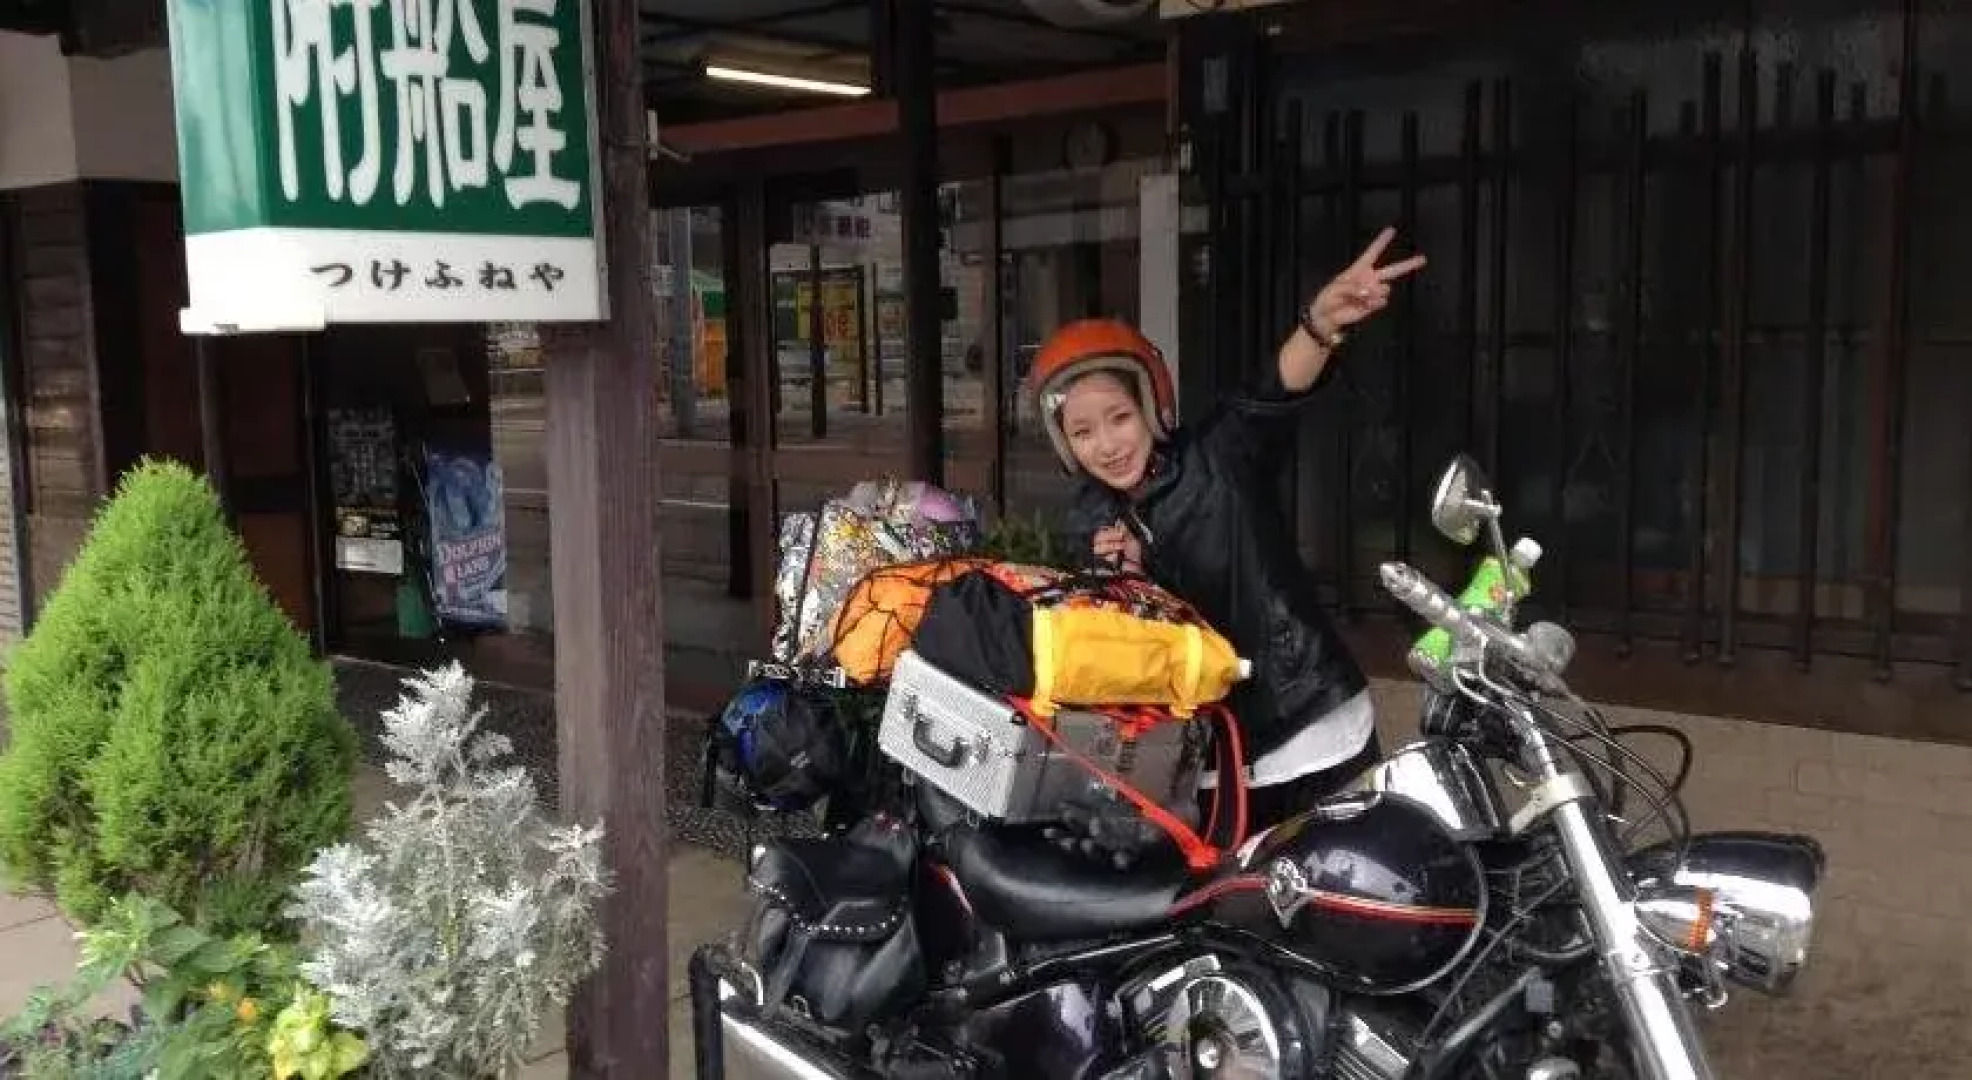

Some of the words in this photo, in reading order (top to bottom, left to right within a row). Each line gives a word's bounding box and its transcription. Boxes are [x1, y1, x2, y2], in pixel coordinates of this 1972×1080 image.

[311, 259, 565, 292] つけふねや
